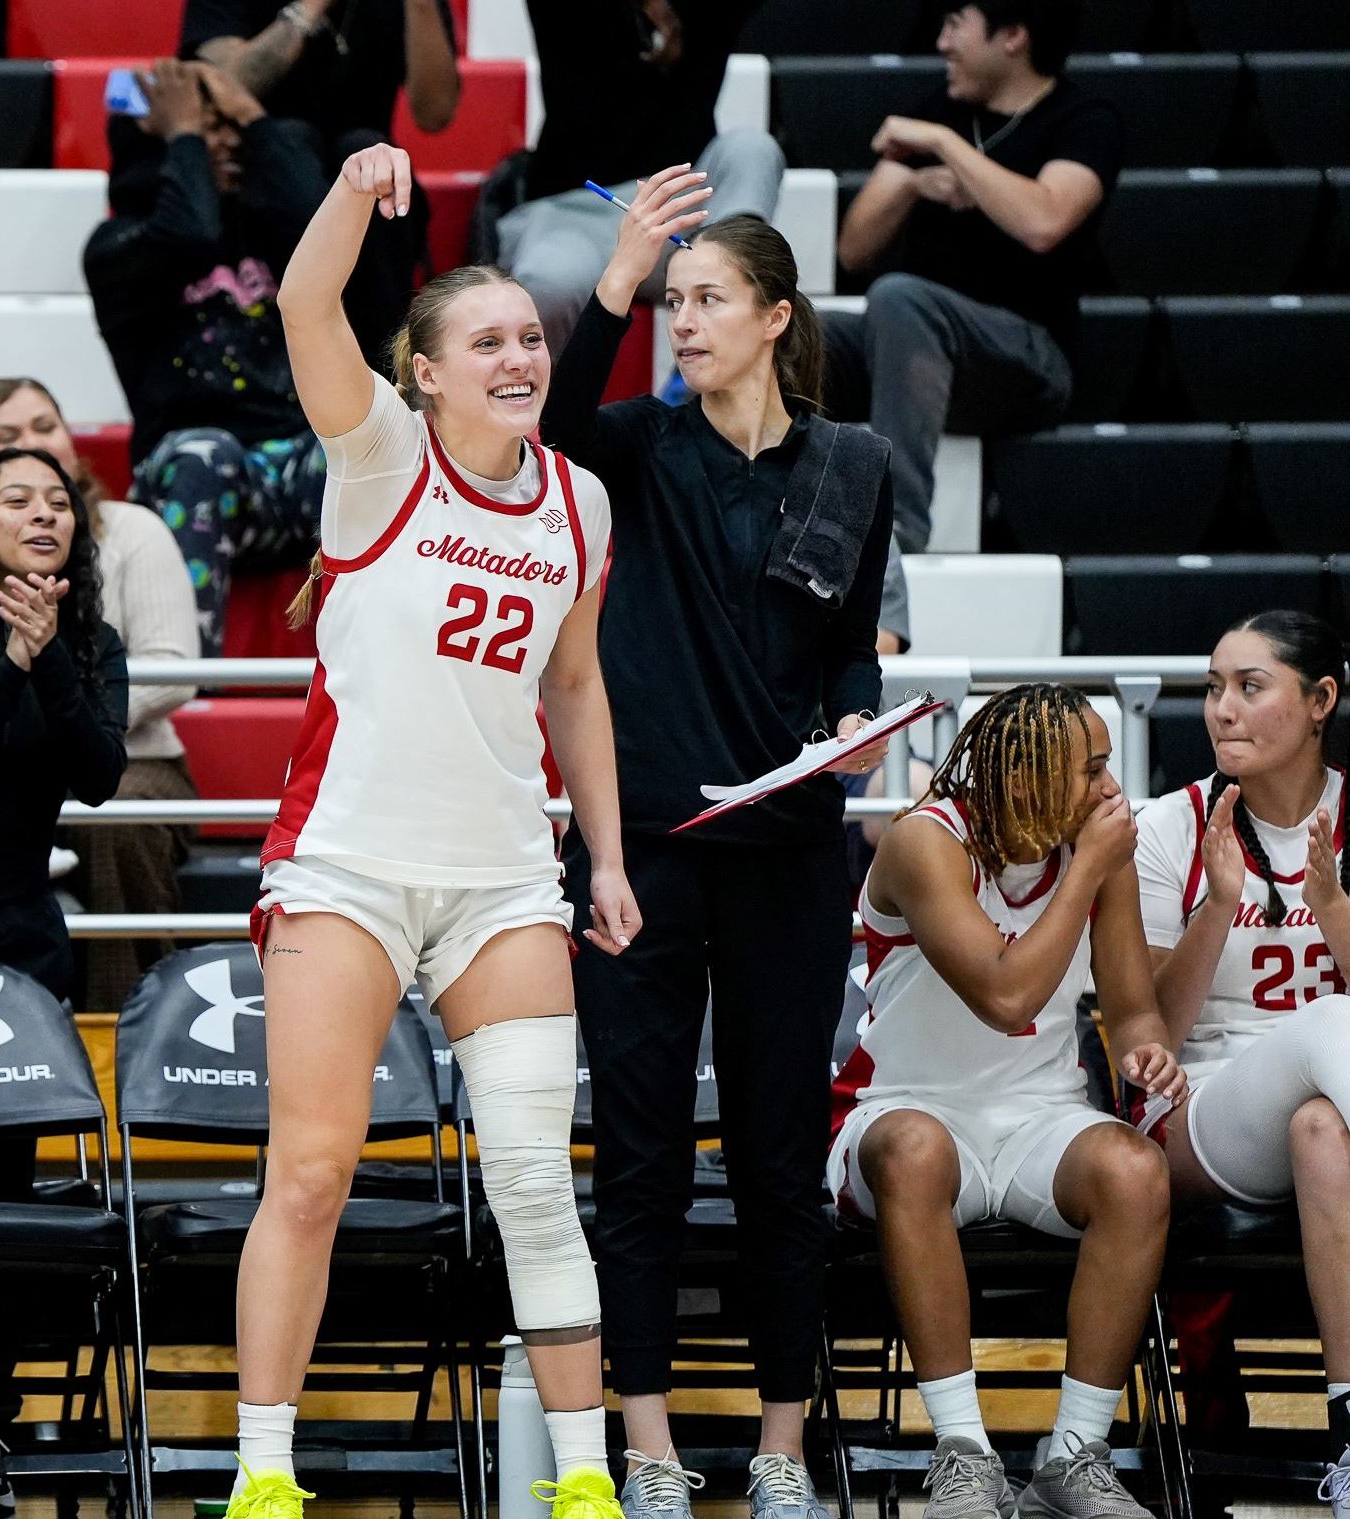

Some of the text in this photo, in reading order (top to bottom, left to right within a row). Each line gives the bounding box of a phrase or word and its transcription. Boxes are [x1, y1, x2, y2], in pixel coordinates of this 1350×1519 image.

[417, 534, 568, 586] Matadors
[437, 583, 534, 675] 22
[1252, 942, 1347, 1011] 23
[163, 1066, 257, 1087] UNDER
